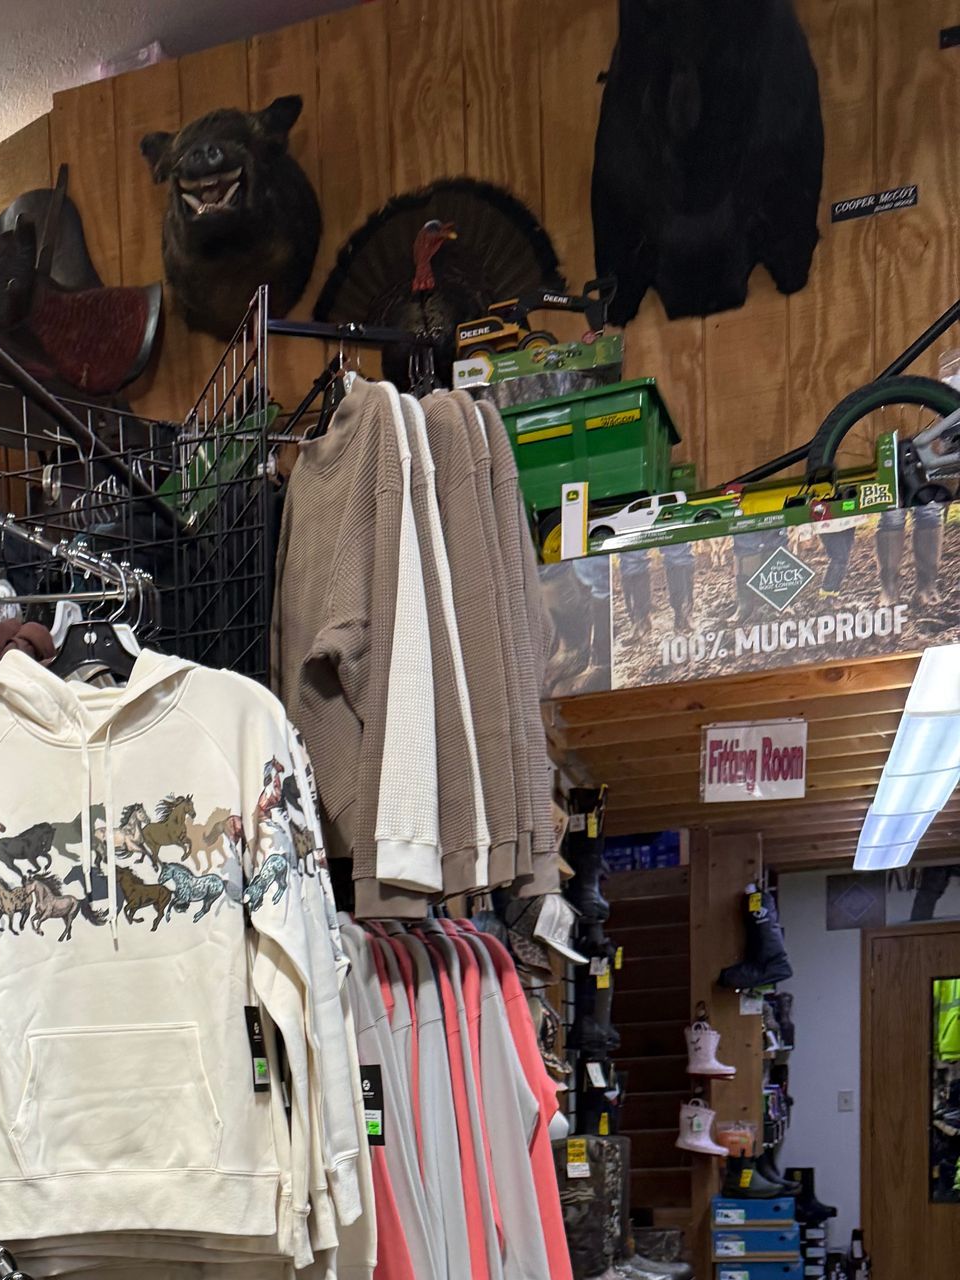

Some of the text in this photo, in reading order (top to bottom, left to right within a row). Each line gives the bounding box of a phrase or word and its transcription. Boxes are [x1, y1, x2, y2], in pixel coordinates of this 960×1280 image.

[834, 195, 875, 215] COOPER
[543, 294, 569, 304] DEERE
[460, 326, 490, 340] DEERE
[759, 567, 804, 585] MUCK
[659, 603, 909, 667] 100% MUCKPROOF
[708, 736, 804, 793] Fitting Room
